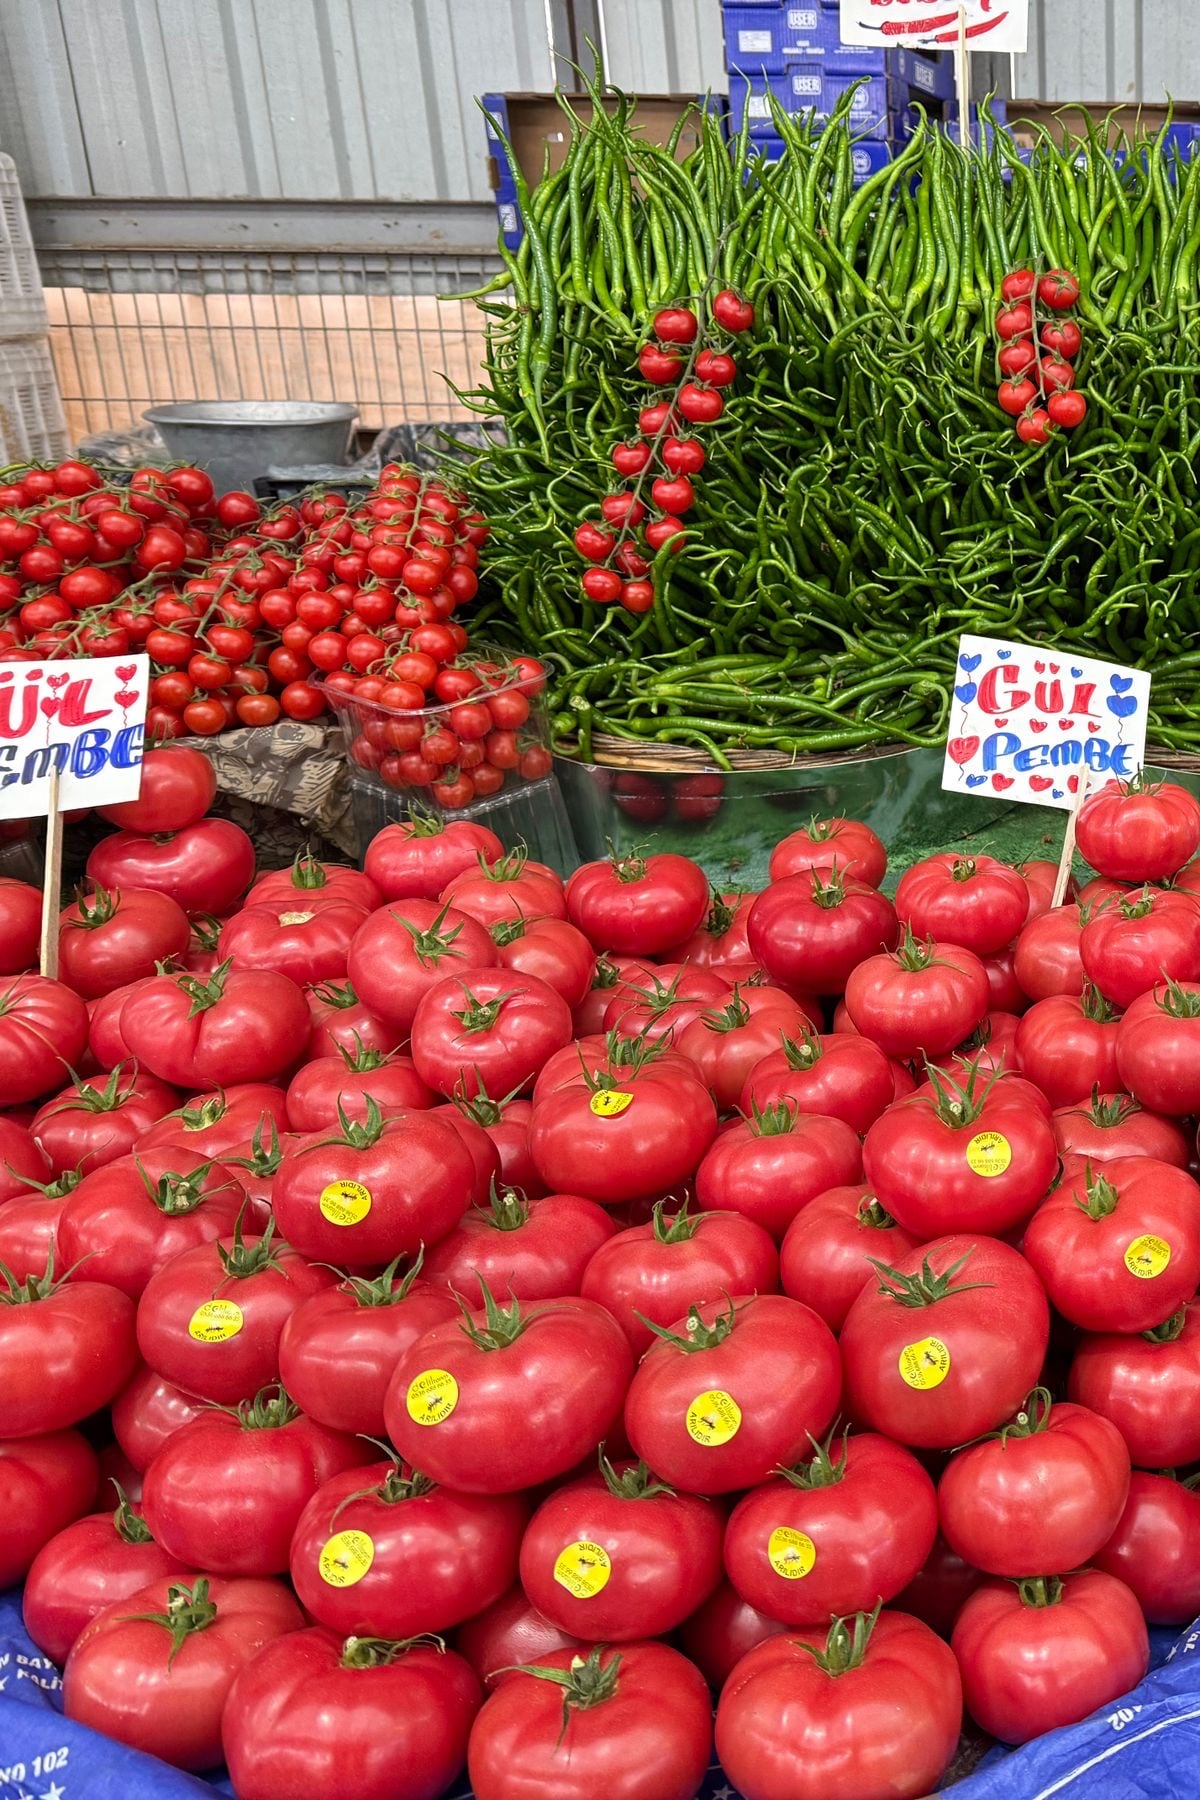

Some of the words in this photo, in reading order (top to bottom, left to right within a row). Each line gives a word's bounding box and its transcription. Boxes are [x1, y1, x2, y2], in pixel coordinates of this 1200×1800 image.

[974, 1133, 1003, 1145] ARILIDIR
[340, 1181, 368, 1201] ARILIDIR
[929, 1339, 948, 1372] ARILIDIR
[419, 1402, 453, 1422] ARILIDIR
[690, 1411, 711, 1442] ARILIDIR
[578, 1544, 608, 1567] ARILIDIR
[774, 1560, 806, 1576] ARILIDIR
[32, 1746, 70, 1777] 102
